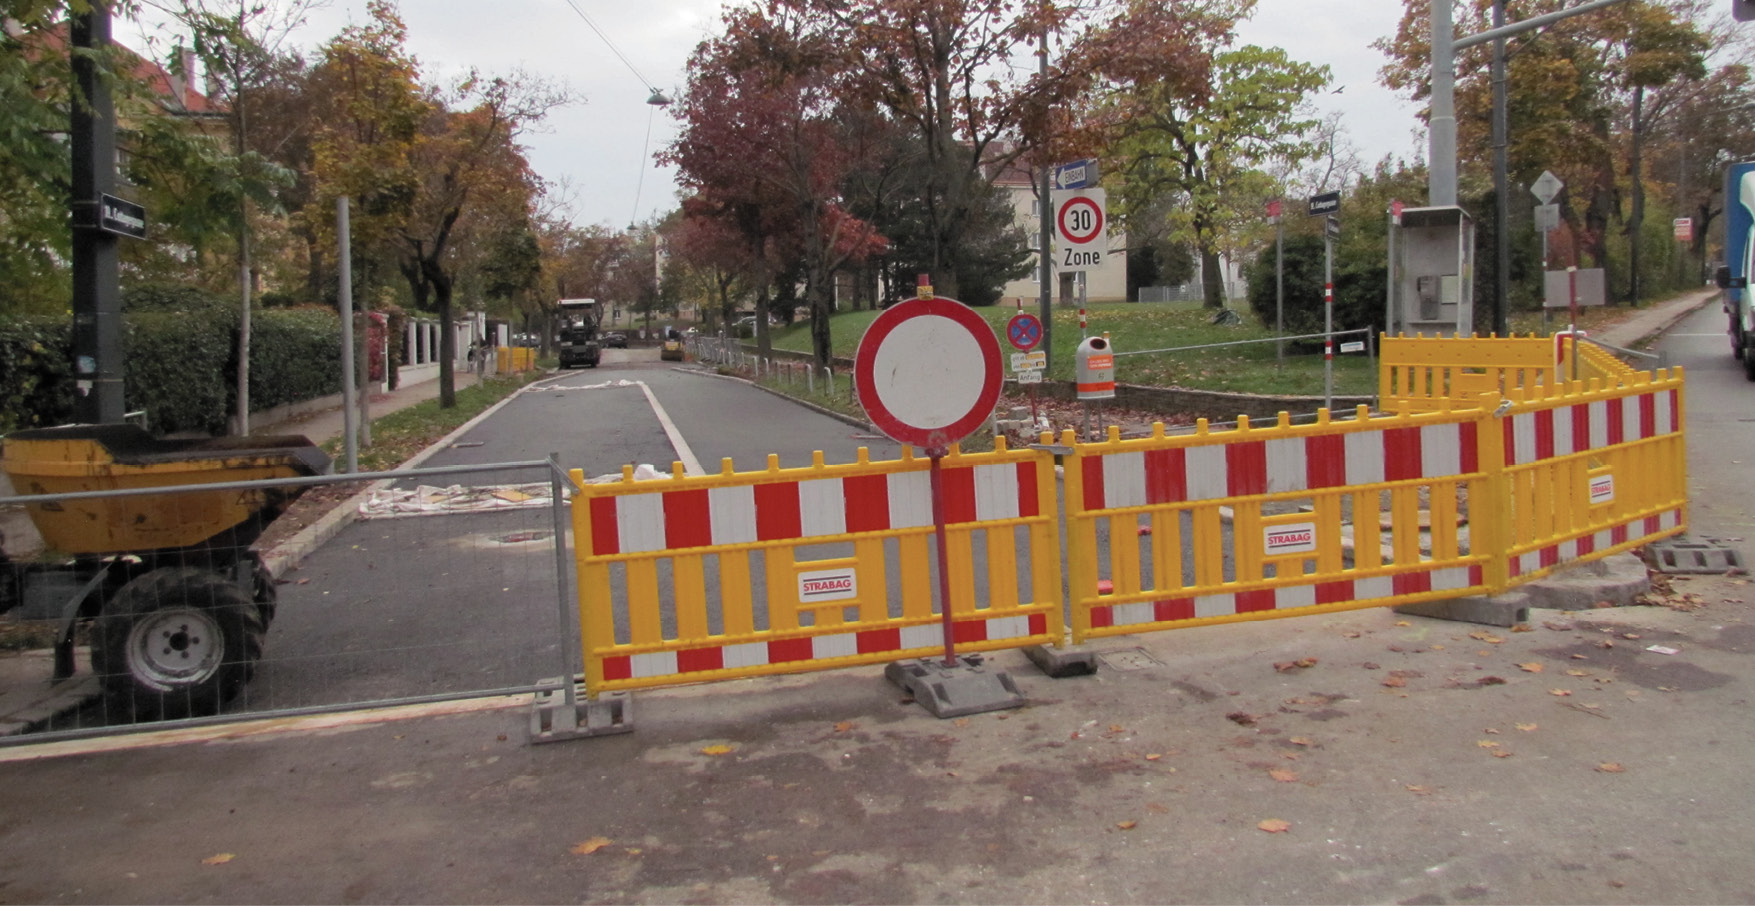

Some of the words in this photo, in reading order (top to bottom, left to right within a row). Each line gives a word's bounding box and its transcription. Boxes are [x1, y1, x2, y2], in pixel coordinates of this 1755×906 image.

[1064, 166, 1084, 183] EINBAHN
[1071, 209, 1091, 231] 30
[1064, 248, 1100, 266] Zone
[1268, 532, 1311, 545] STRABAG
[803, 579, 851, 592] STRABAG
